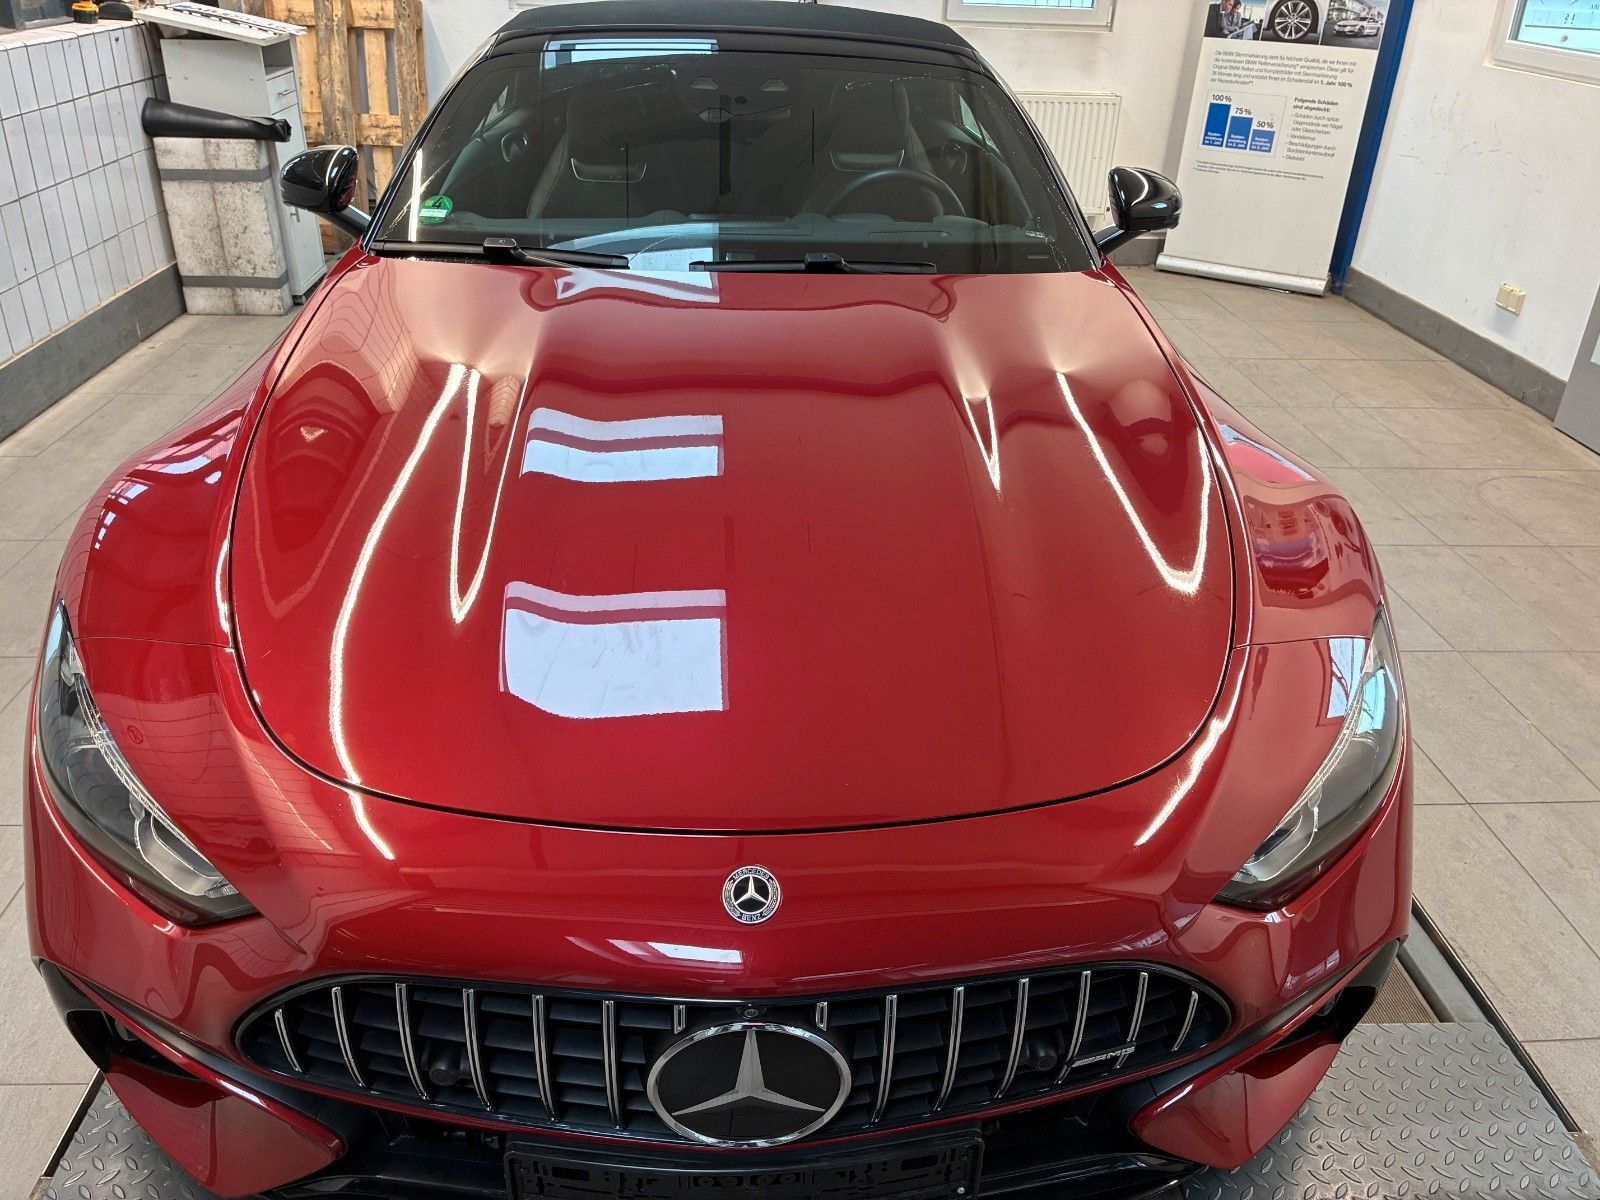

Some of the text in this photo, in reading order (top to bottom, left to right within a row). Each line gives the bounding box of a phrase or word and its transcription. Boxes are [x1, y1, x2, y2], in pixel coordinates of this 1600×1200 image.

[432, 196, 444, 209] 4
[733, 868, 769, 881] MERCEDES
[741, 914, 762, 922] BENZ
